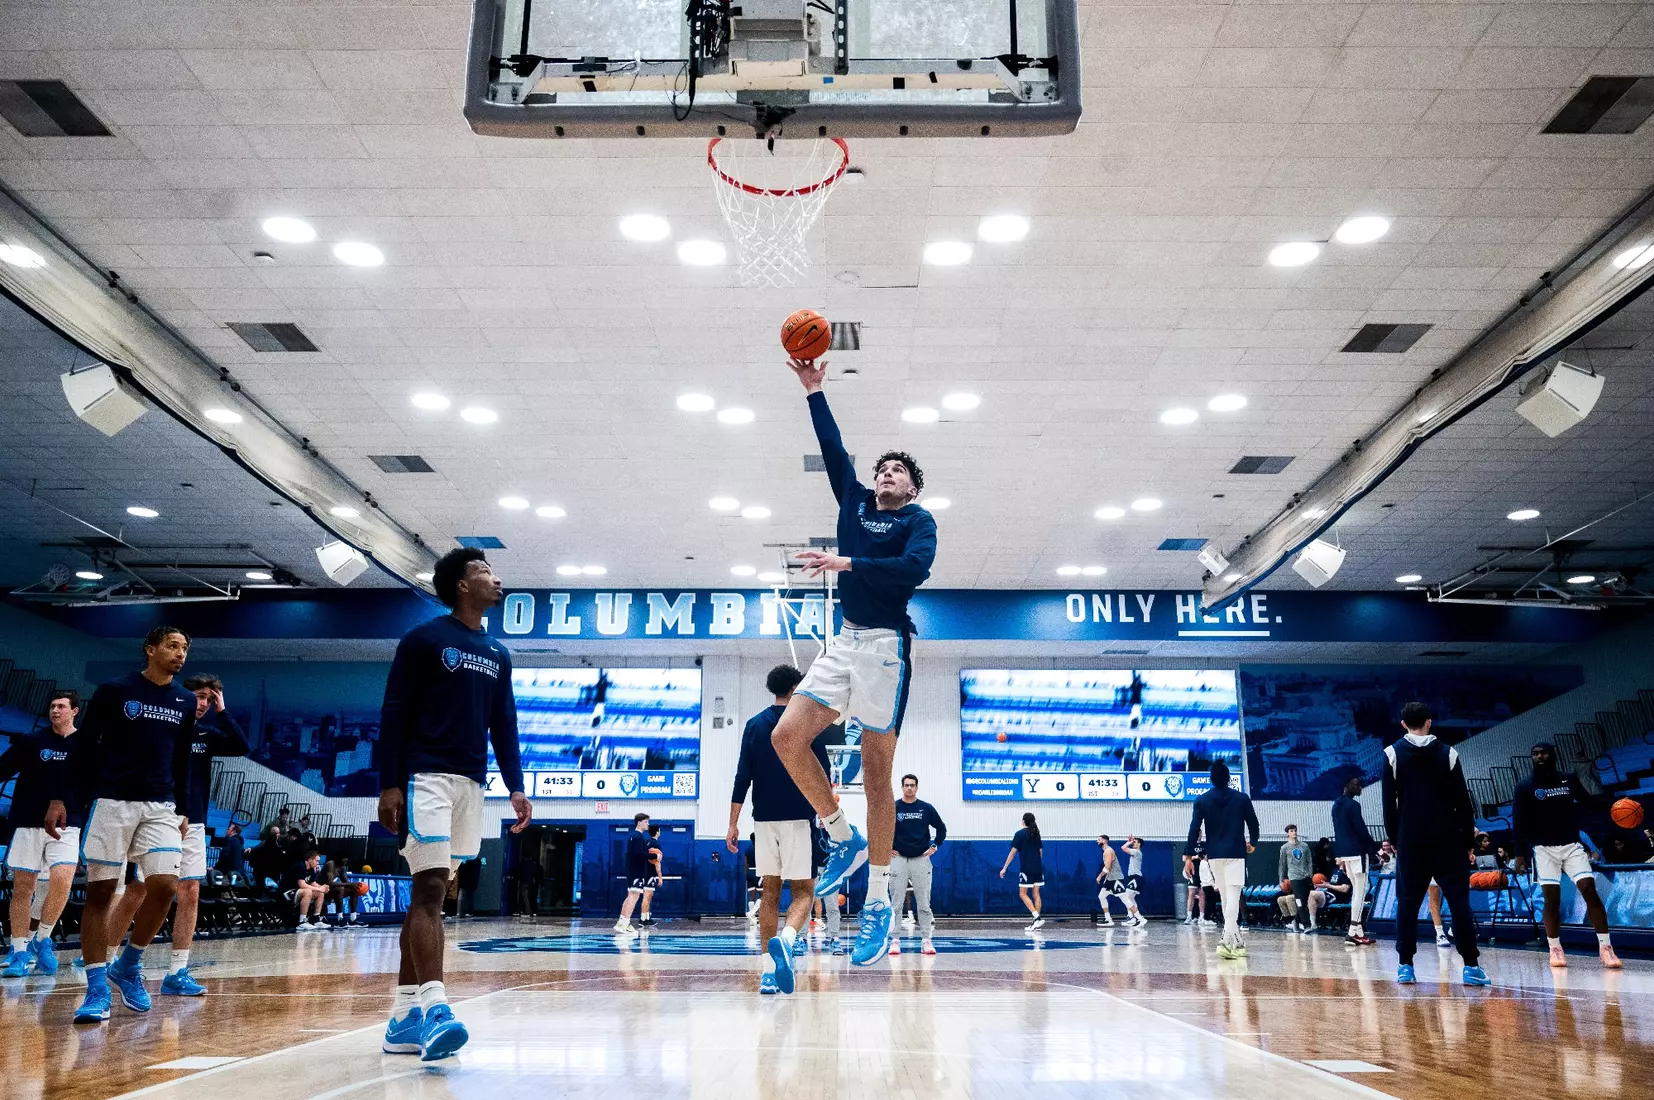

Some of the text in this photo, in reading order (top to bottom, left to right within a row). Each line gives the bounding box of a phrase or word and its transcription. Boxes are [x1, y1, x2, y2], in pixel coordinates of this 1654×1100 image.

[481, 592, 824, 635] OLUMBIA
[1066, 593, 1155, 623] ONLY
[462, 652, 499, 670] COLUMBIA
[464, 663, 498, 678] BASKETBALL
[143, 704, 182, 718] COLUMBIA
[144, 713, 180, 724] BASKETBALL
[543, 777, 573, 785] 41:33
[596, 780, 605, 790] 0
[1025, 778, 1040, 793] Y
[1088, 779, 1118, 787] 41:33
[1142, 781, 1151, 791] 0
[640, 786, 671, 794] PROGRAM
[1056, 782, 1065, 792] 0
